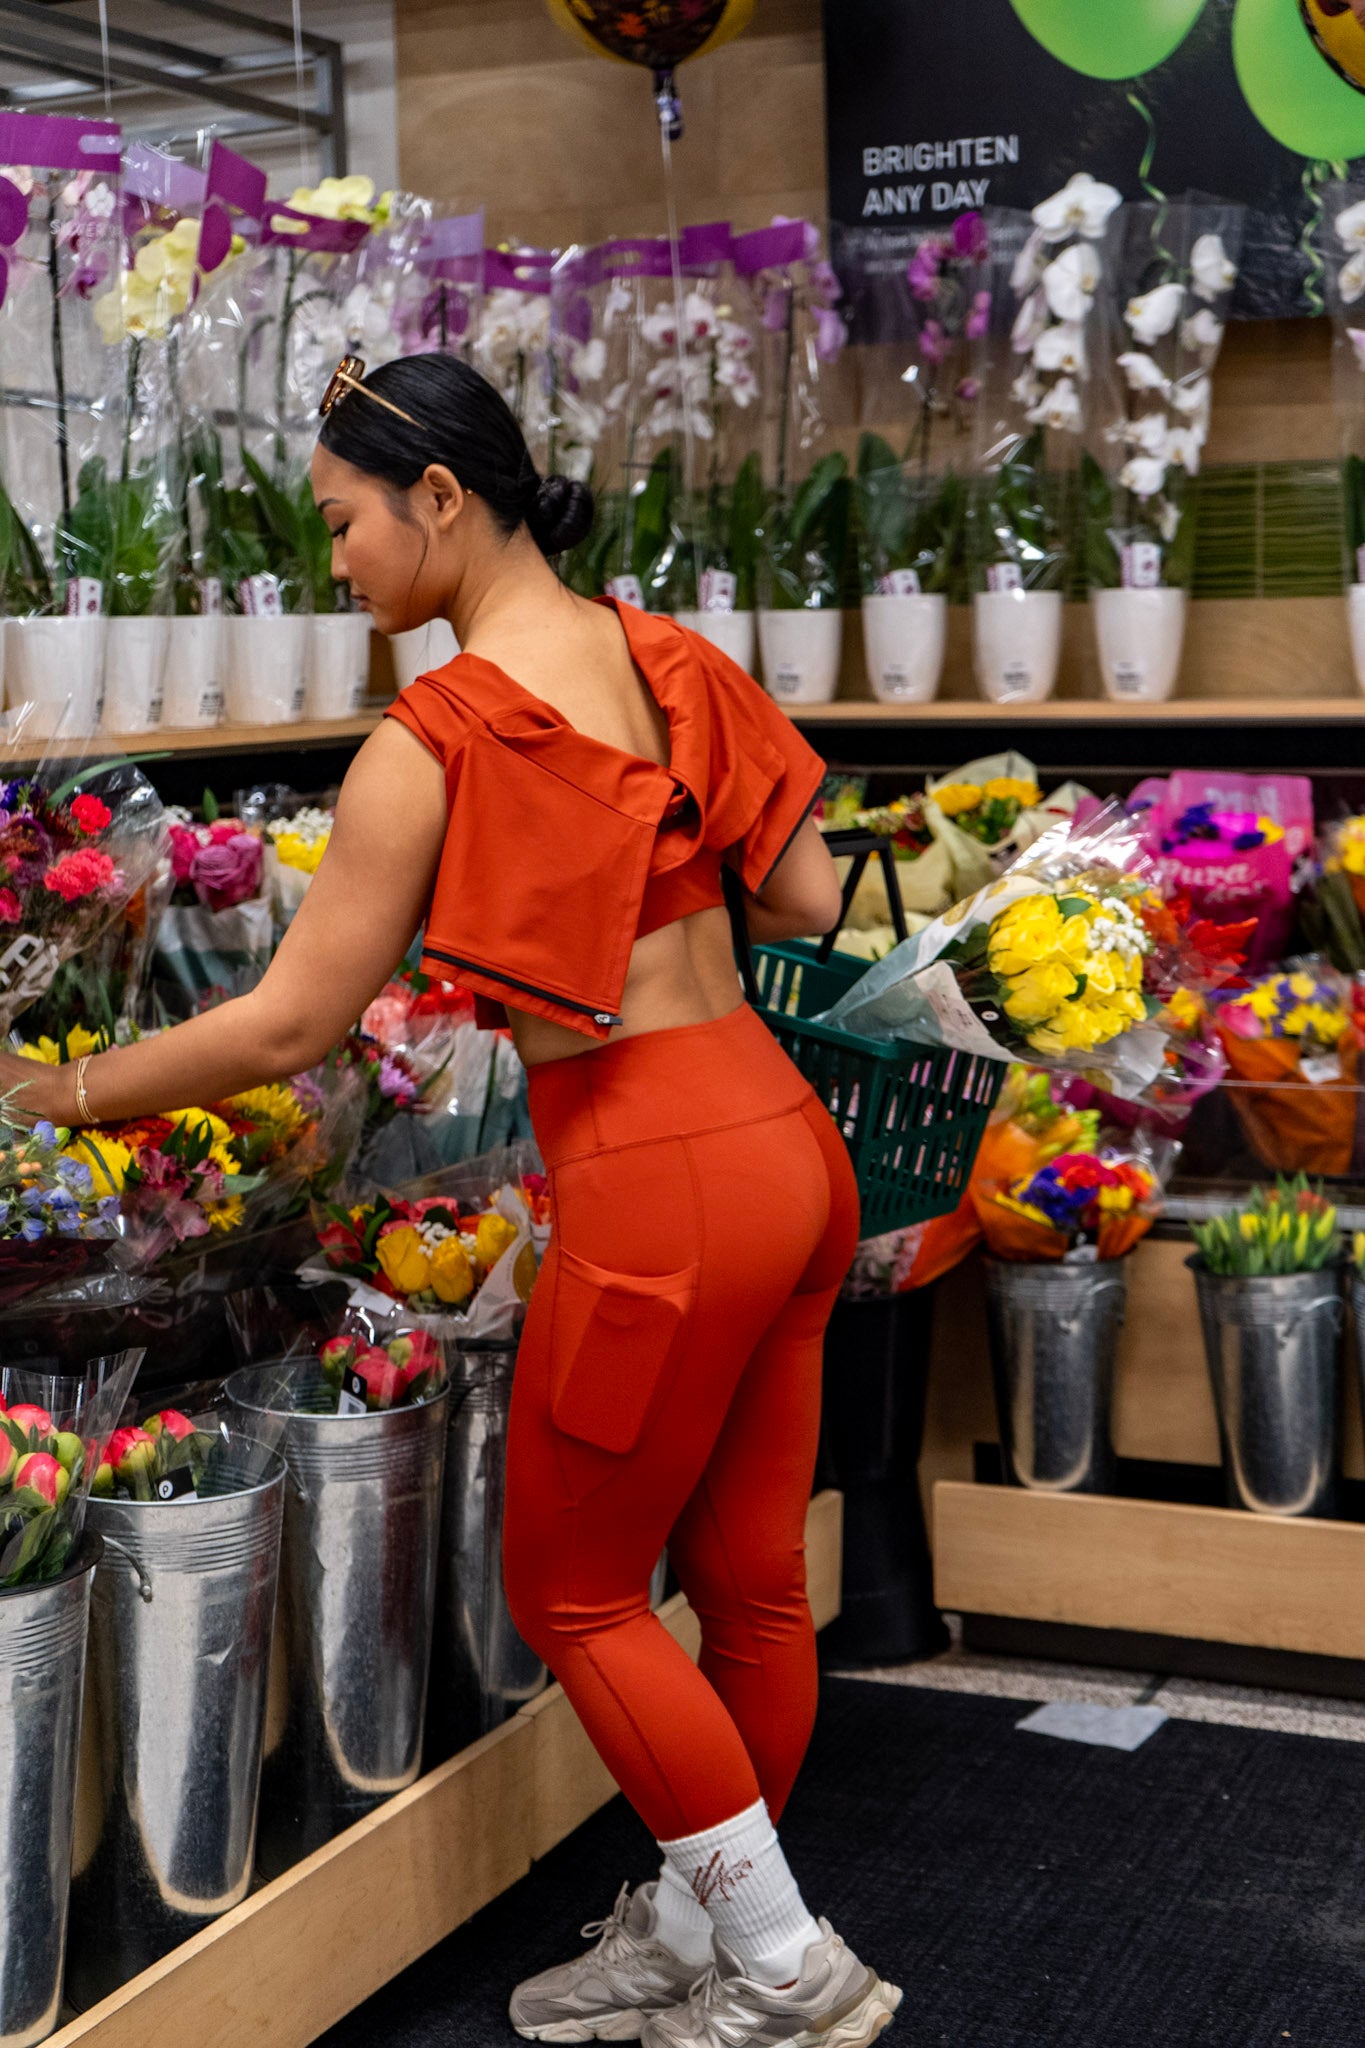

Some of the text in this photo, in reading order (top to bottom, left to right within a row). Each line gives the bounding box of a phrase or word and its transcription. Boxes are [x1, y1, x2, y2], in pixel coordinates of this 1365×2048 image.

[862, 134, 1019, 176] BRIGHTEN
[862, 177, 990, 217] ANY DAY
